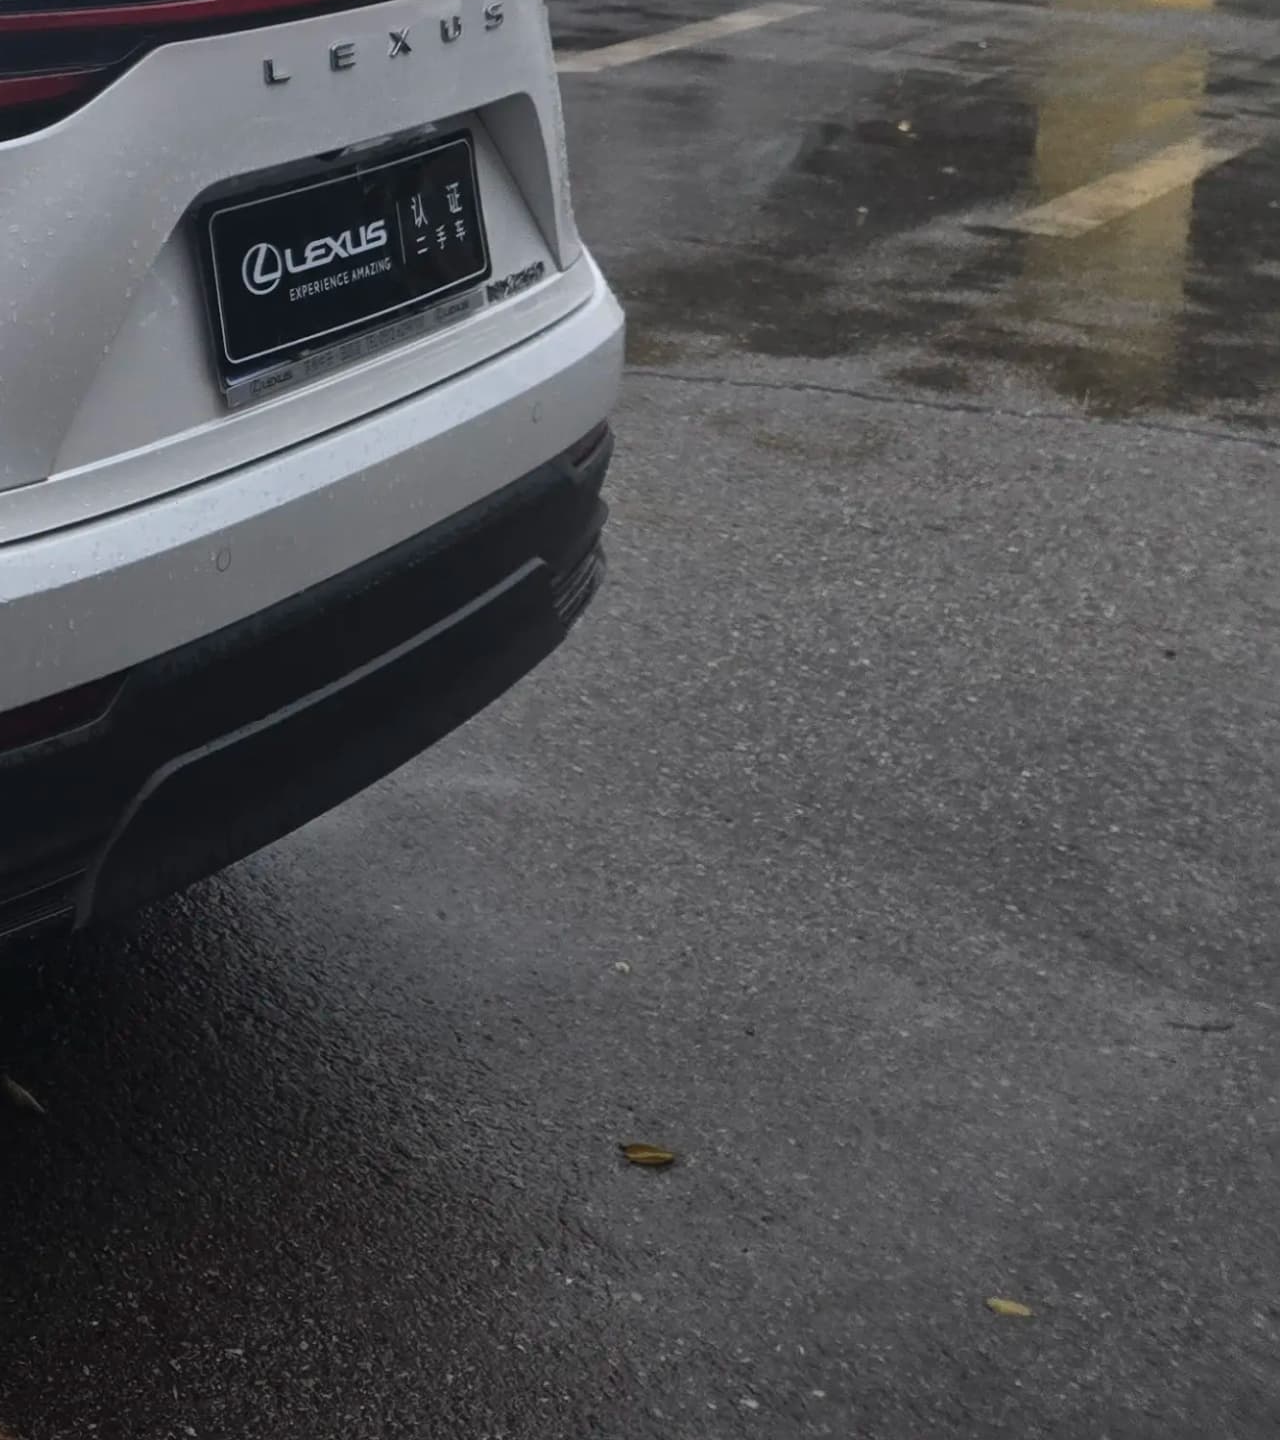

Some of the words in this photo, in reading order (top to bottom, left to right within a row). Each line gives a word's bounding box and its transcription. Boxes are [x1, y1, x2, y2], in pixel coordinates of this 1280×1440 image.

[263, 2, 505, 86] LEXUS
[284, 219, 388, 275] LEXUS
[416, 219, 466, 255] 二手车
[289, 271, 351, 303] EXPERIENCE
[351, 256, 392, 283] AMAZING
